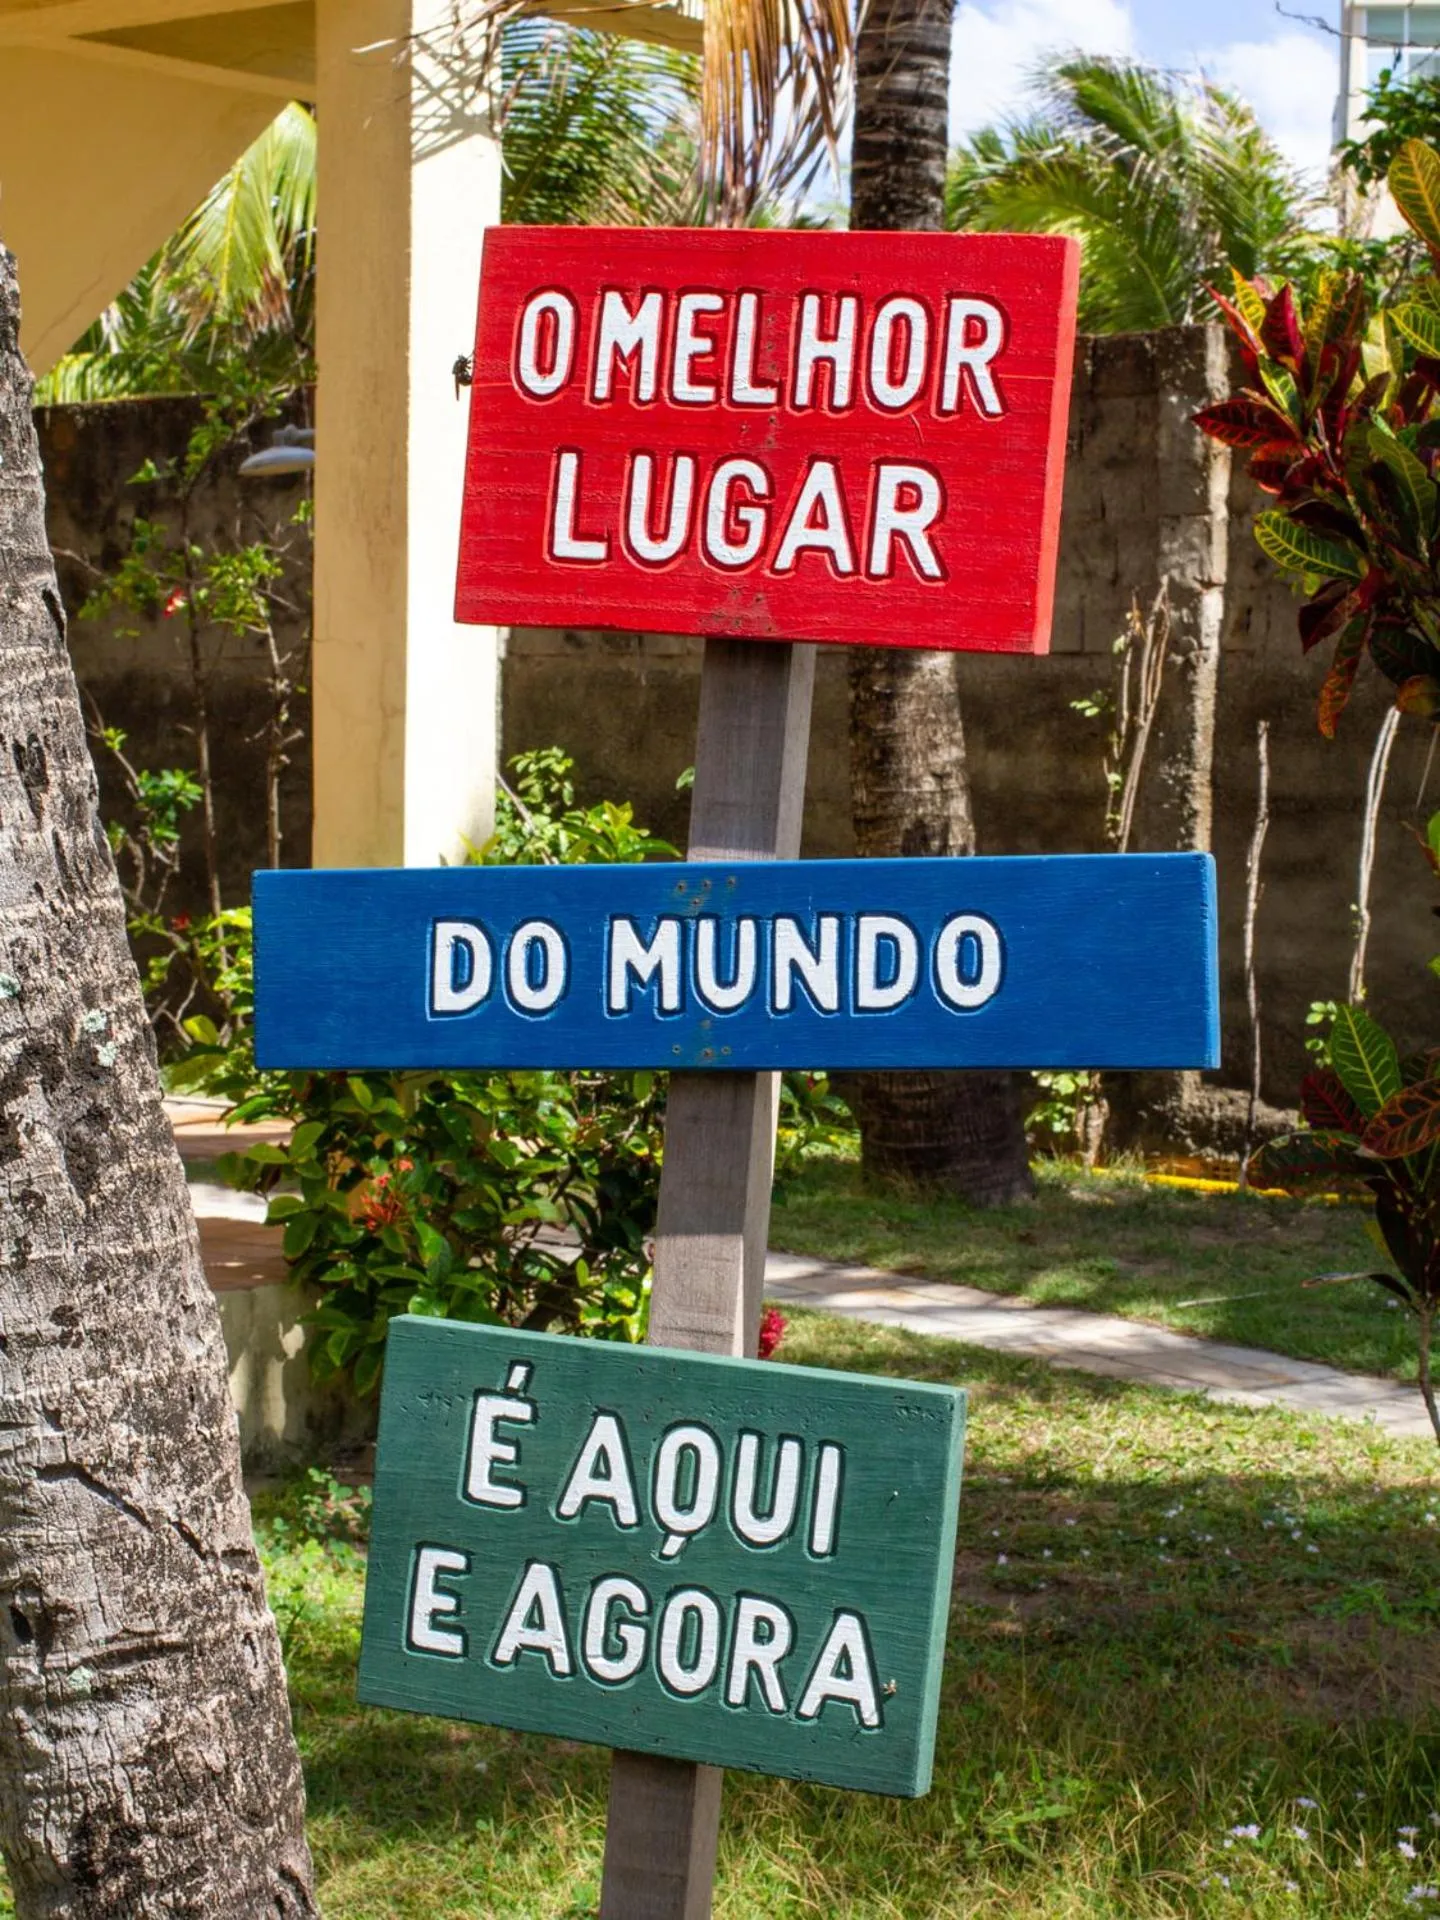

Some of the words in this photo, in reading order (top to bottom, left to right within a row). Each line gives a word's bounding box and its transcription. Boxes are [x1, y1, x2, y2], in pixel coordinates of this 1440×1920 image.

[518, 291, 576, 396] O
[591, 290, 1004, 416] MELHOR
[551, 451, 943, 579] LUGAR
[431, 919, 566, 1013] DO
[607, 913, 1003, 1012] MUNDO
[465, 1363, 534, 1507] É
[556, 1413, 842, 1558] AQUI
[409, 1546, 469, 1656] E
[493, 1561, 881, 1728] AGORA
